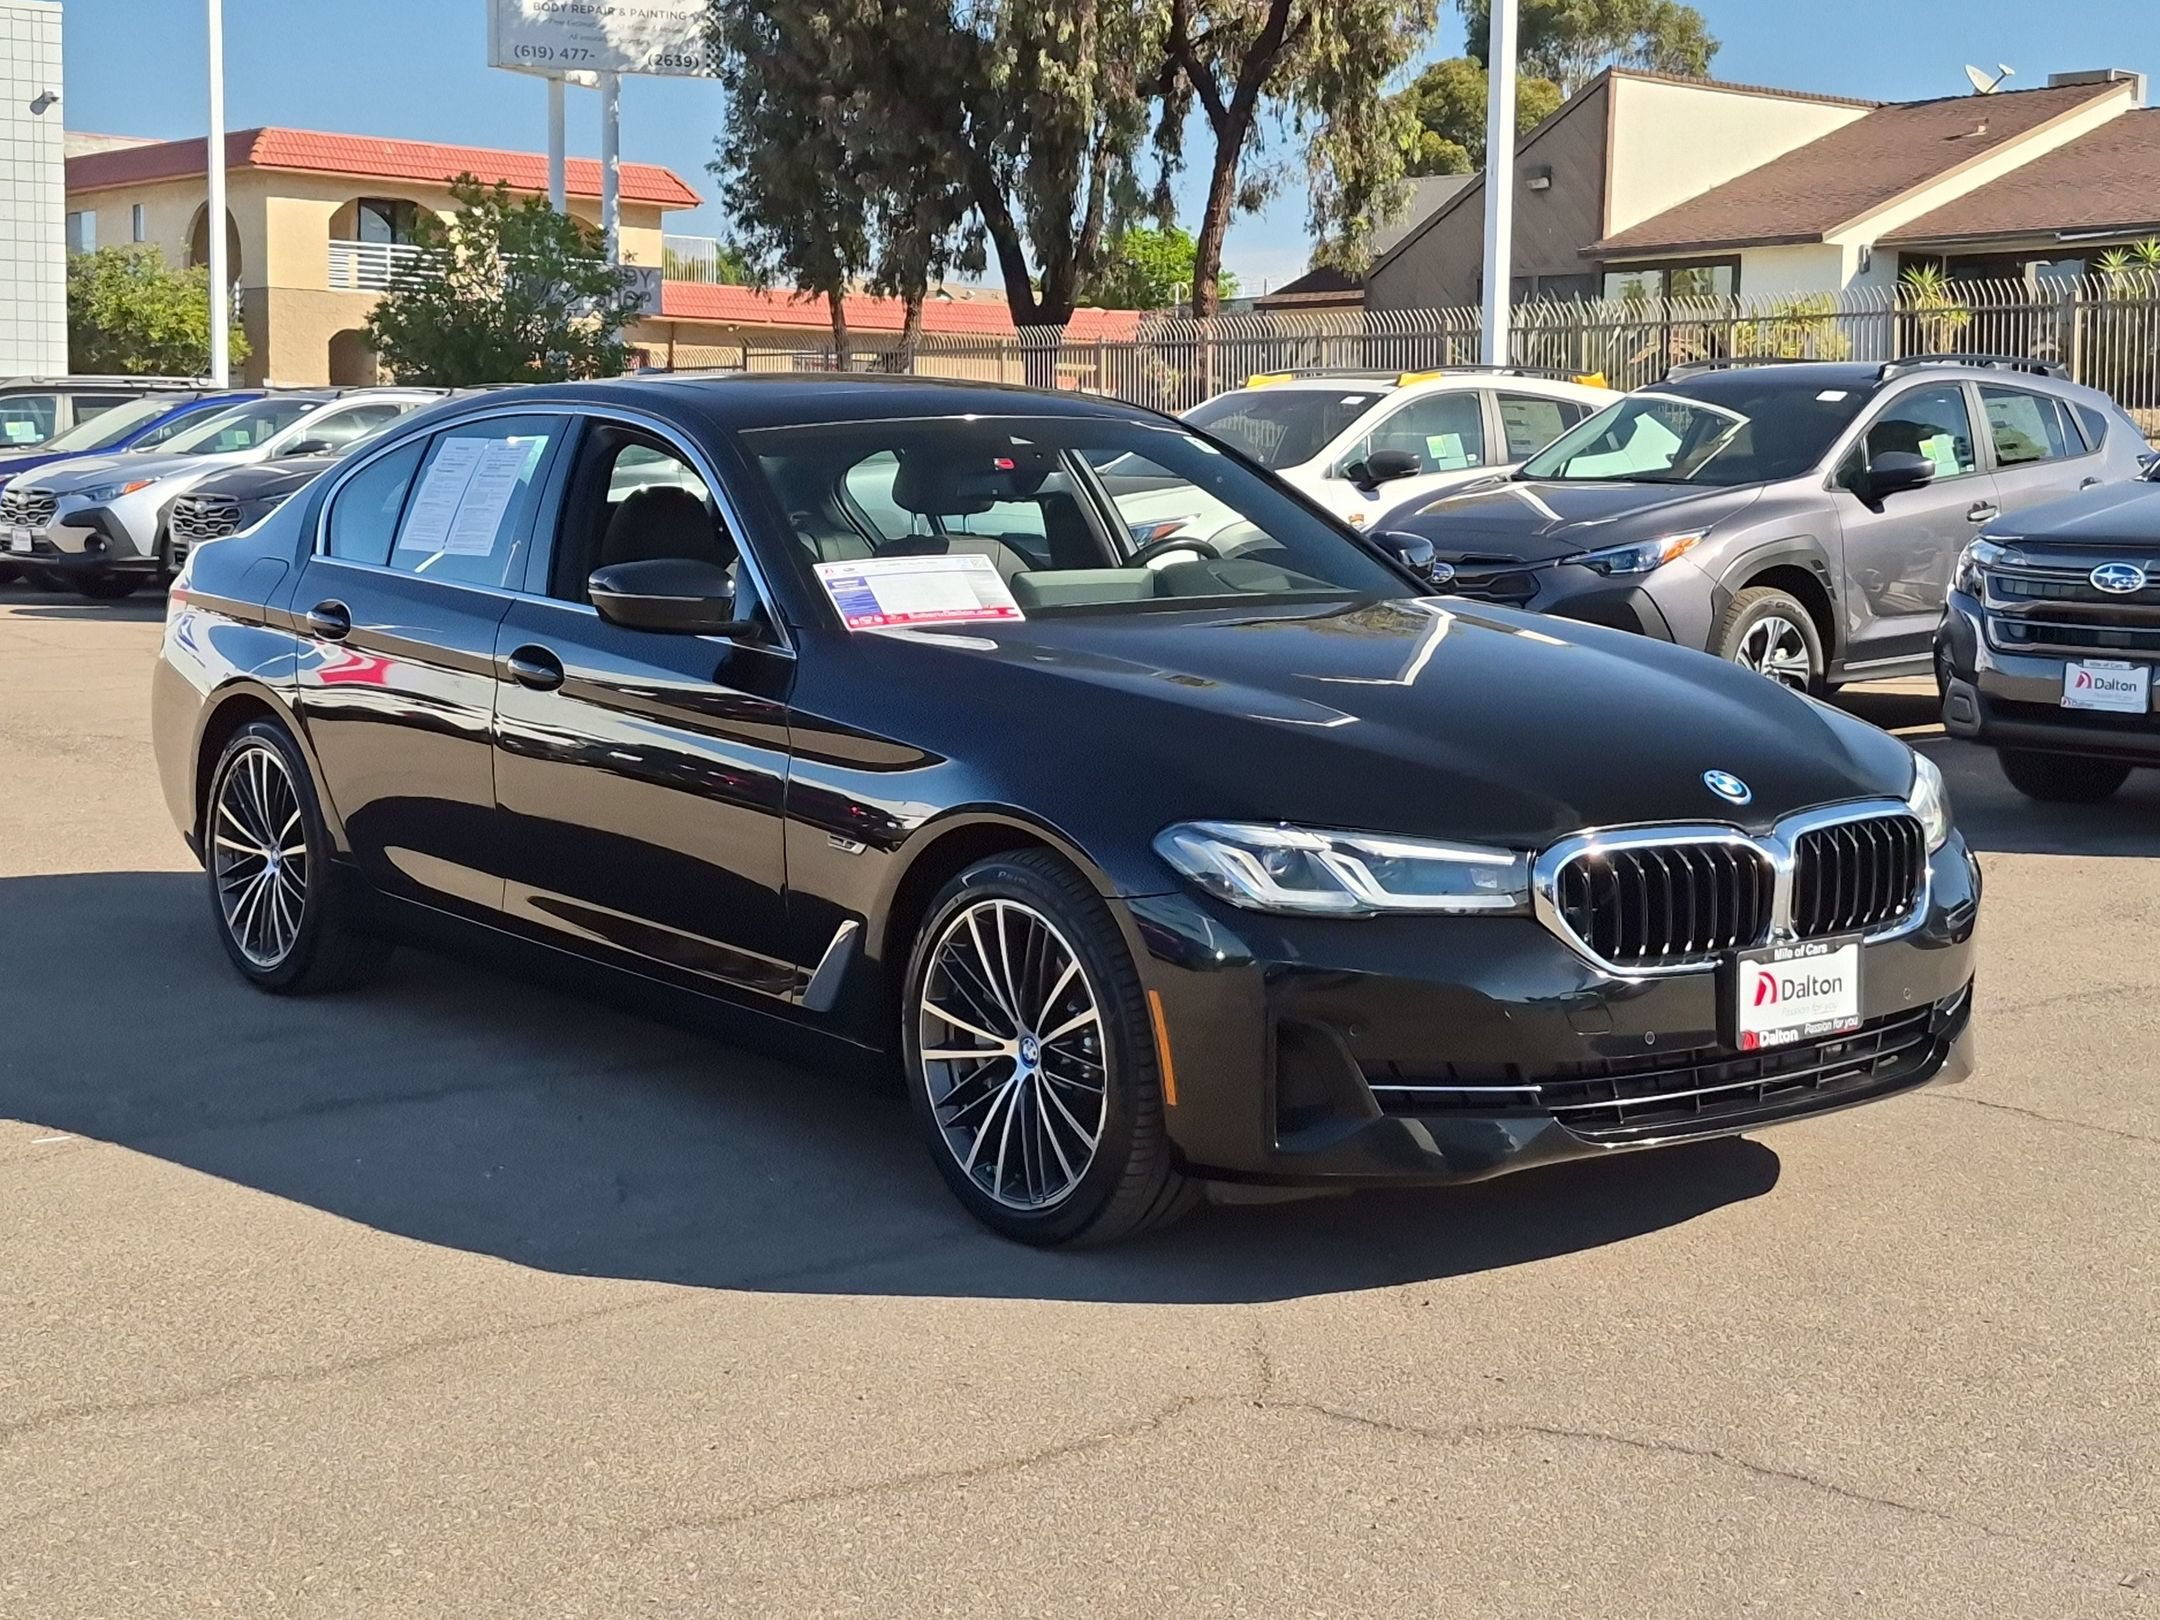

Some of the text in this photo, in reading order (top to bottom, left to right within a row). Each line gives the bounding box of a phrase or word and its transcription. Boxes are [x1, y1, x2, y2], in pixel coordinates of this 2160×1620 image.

[533, 2, 688, 21] BODY REPAIR & PAINTING
[514, 44, 700, 69] (619) 477- (2639)
[2094, 678, 2137, 692] Dalton
[1774, 942, 1828, 961] Mile of Cars
[1782, 975, 1842, 1001] Dalton
[1759, 1029, 1799, 1047] Dalton
[1804, 1020, 1832, 1035] Passion
[1832, 1017, 1843, 1030] for
